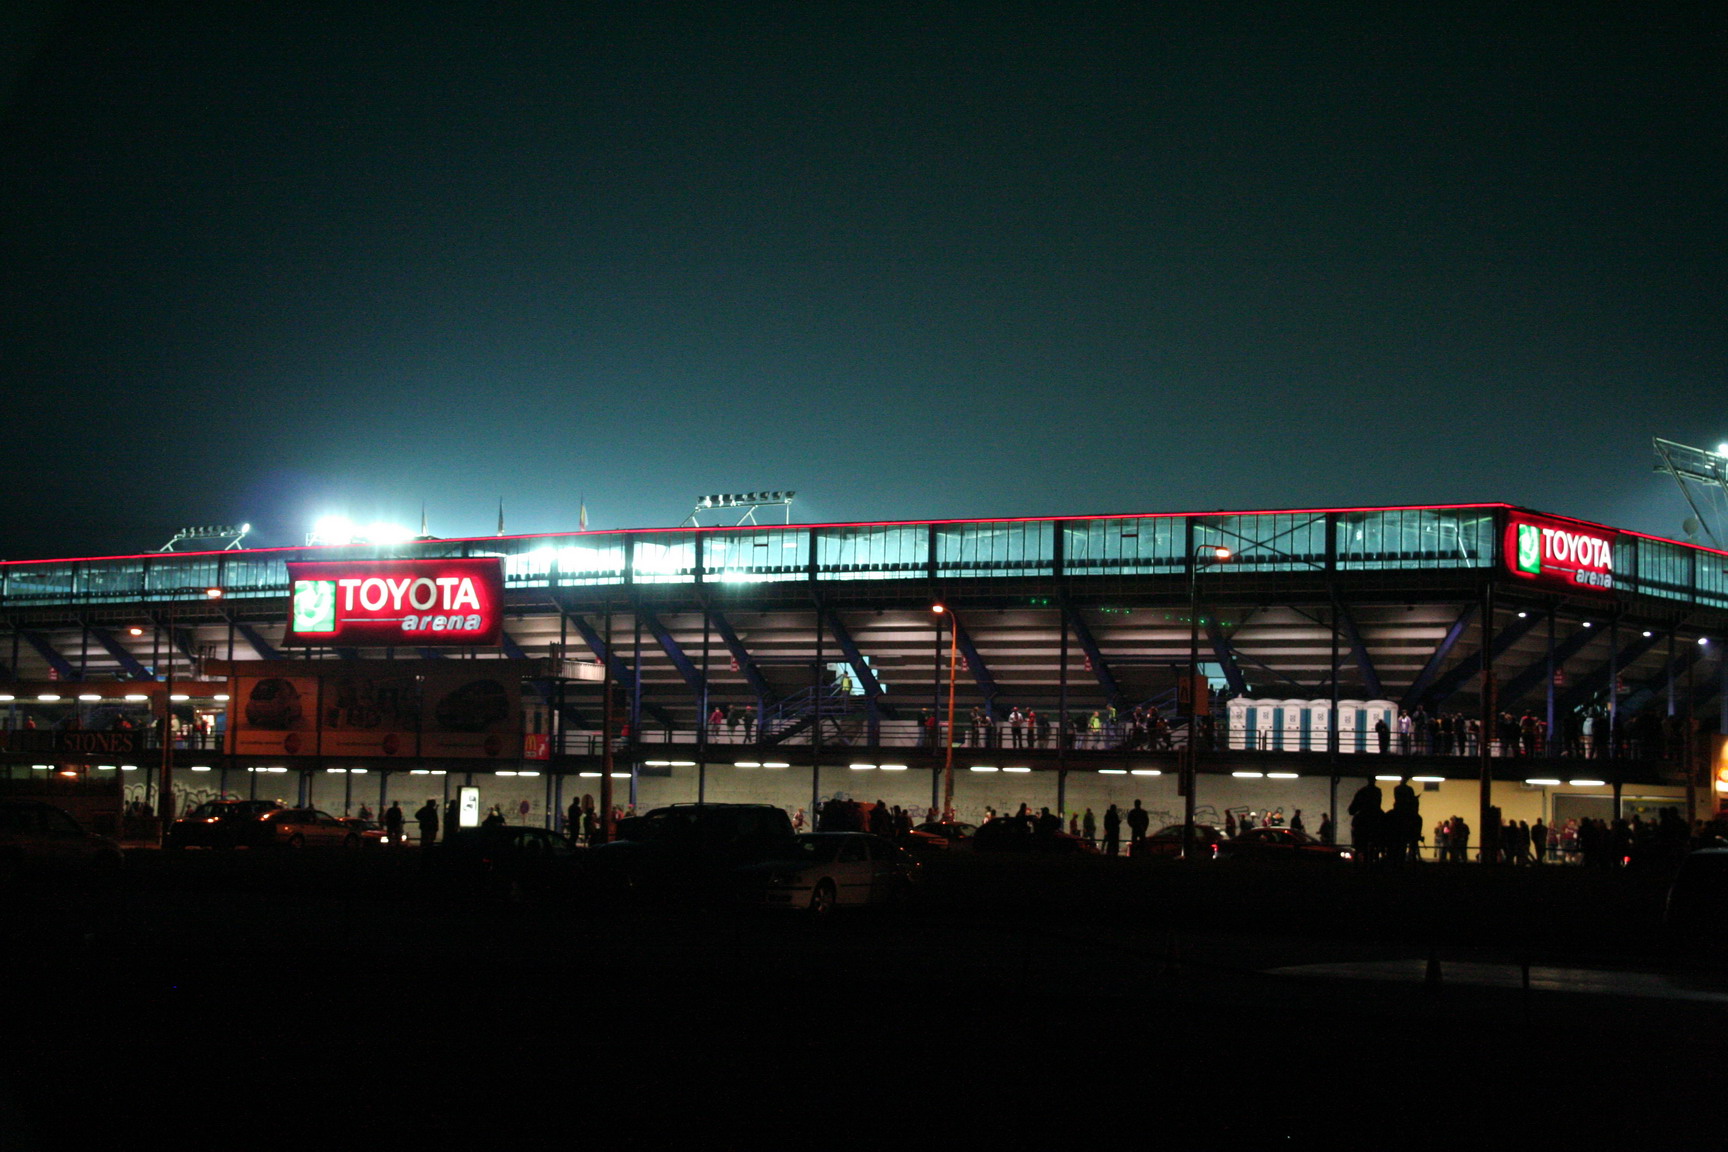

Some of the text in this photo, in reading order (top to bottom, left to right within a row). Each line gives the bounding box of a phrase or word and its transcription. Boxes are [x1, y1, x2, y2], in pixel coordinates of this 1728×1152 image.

[1542, 528, 1612, 570] TOYOTA
[1576, 569, 1612, 588] arena
[338, 577, 480, 611] TOYOTA
[401, 614, 482, 631] arena
[64, 732, 134, 753] STONES
